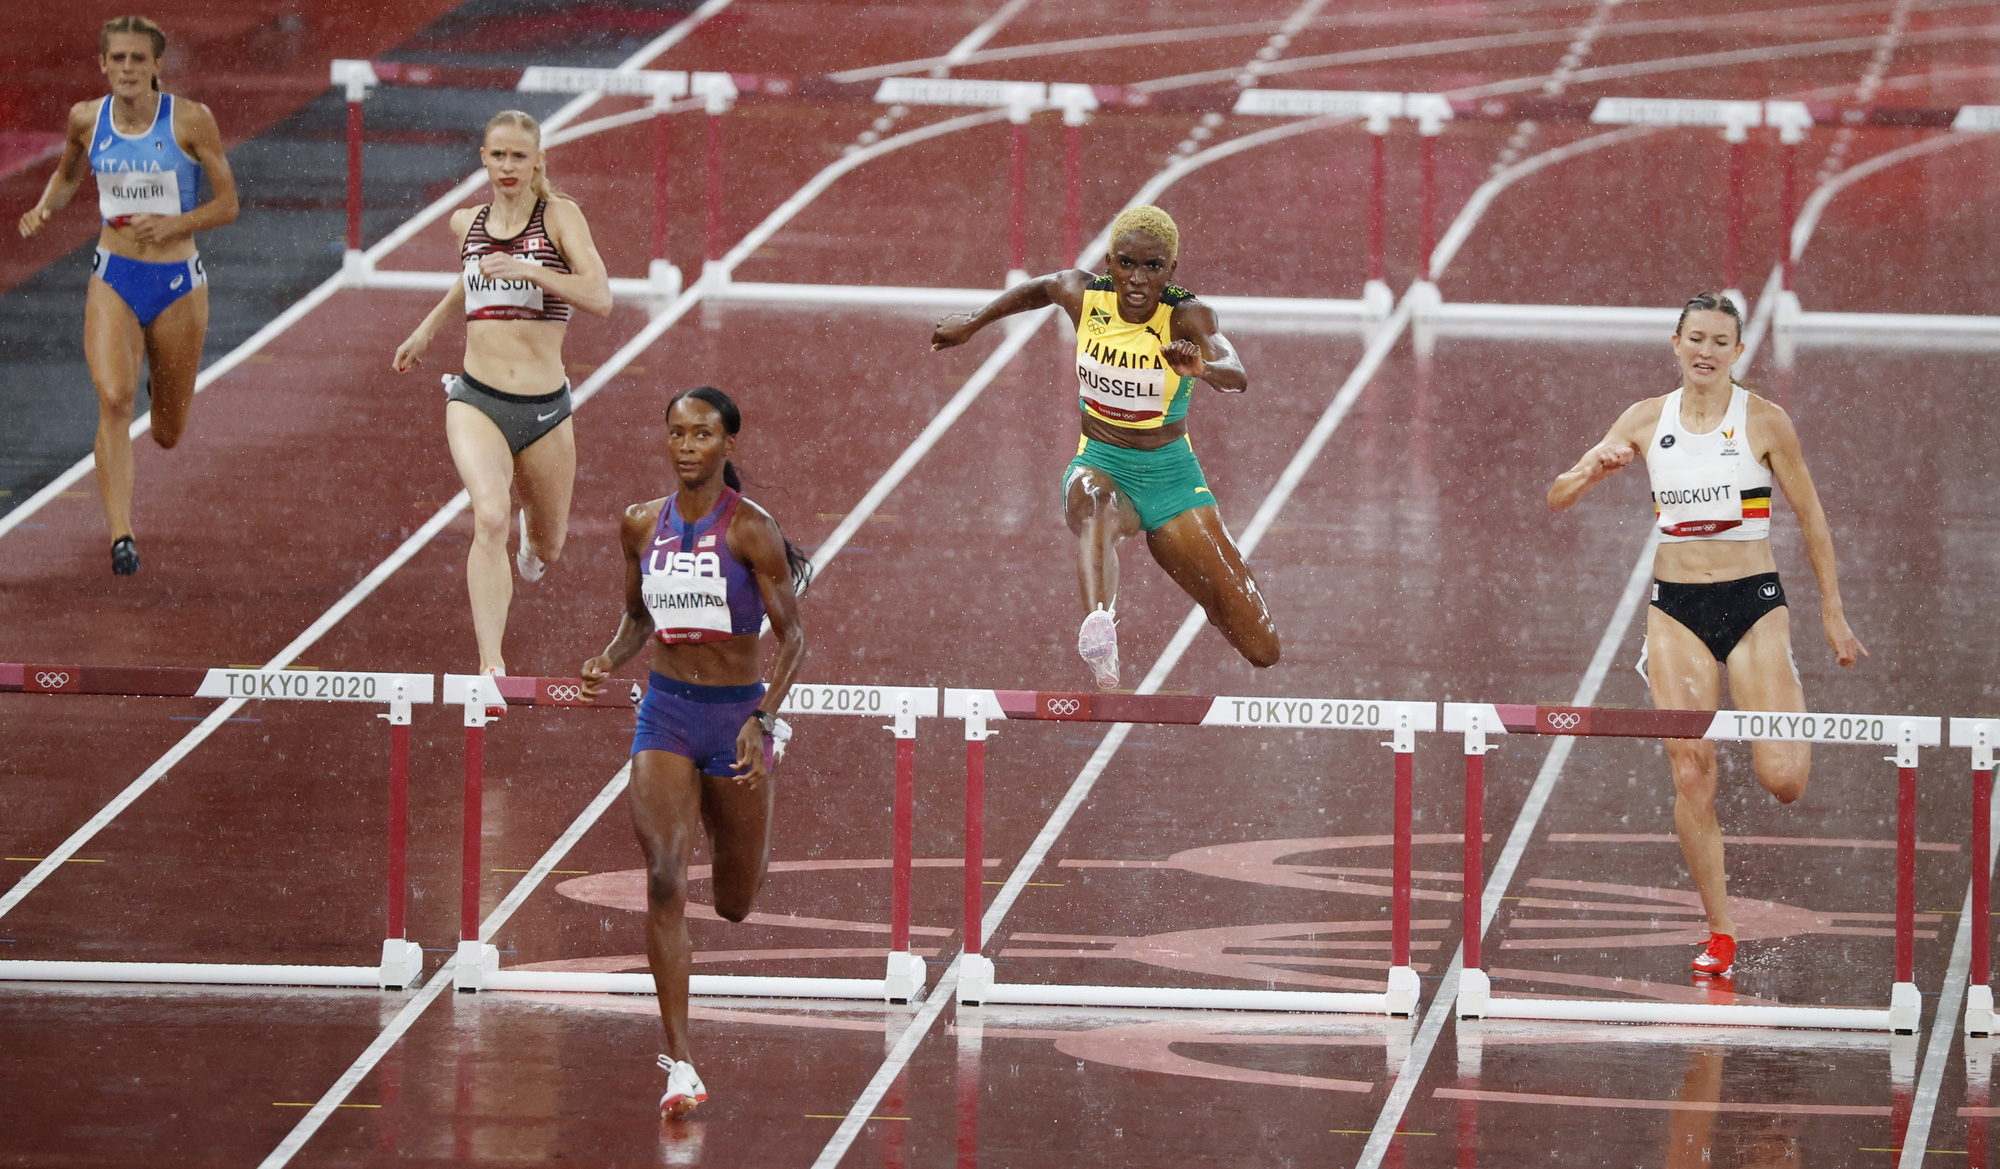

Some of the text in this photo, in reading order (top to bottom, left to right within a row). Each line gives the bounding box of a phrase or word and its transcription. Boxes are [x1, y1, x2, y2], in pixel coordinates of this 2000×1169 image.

[102, 159, 162, 173] ITALIA
[112, 184, 164, 198] OLIVIERI
[467, 274, 537, 292] WATSON
[1085, 338, 1163, 370] JAMAICA
[1078, 364, 1160, 398] RUSSELL
[1660, 485, 1731, 505] COUCKUYT
[648, 550, 720, 580] USA
[643, 592, 724, 609] MUHAMMAD
[225, 673, 376, 698] TOKYO 2020
[821, 688, 881, 711] 2020
[1232, 700, 1380, 726] TOKYO 2020
[1733, 715, 1884, 741] TOKYO 2020
